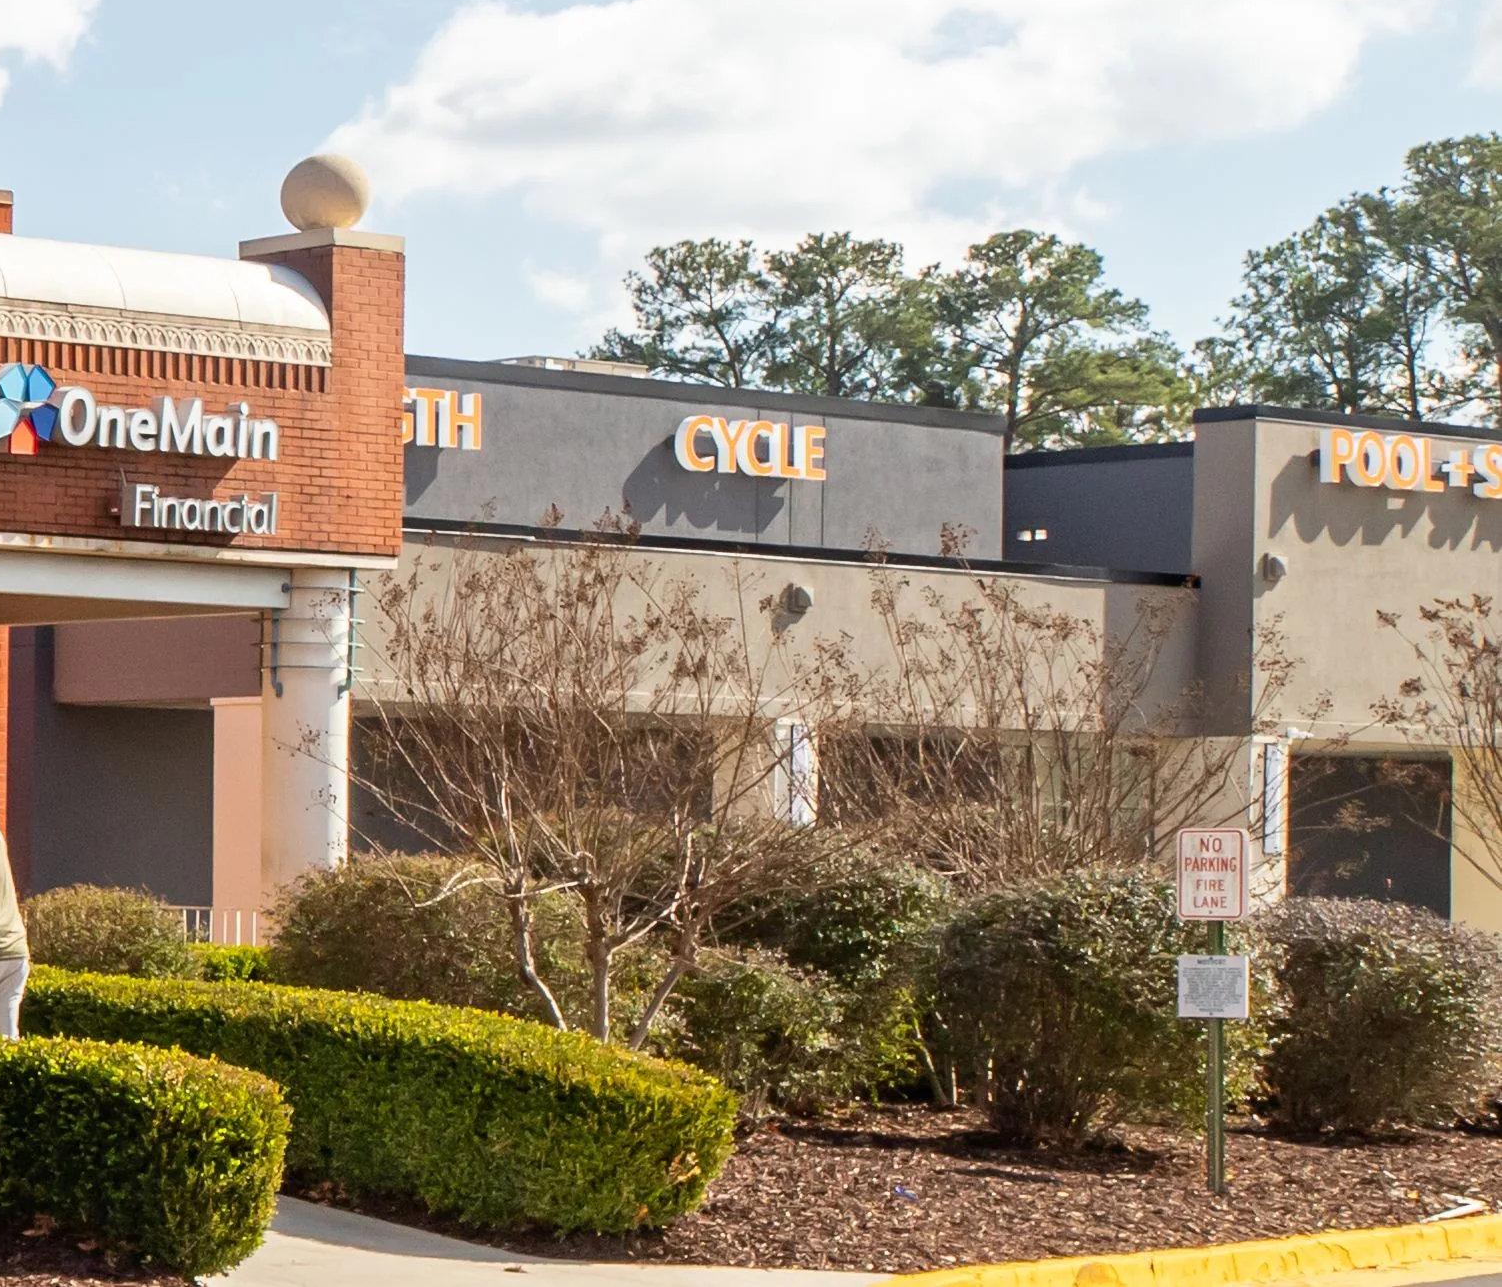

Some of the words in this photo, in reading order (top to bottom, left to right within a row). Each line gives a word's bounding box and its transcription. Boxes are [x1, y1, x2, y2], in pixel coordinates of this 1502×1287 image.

[56, 386, 279, 462] OneMain
[676, 413, 827, 482] CYCLE
[131, 482, 278, 536] Financial
[1200, 837, 1222, 852] NO
[1184, 856, 1237, 873] PARKING
[1196, 879, 1225, 892] FIRE
[1193, 896, 1227, 909] LANE
